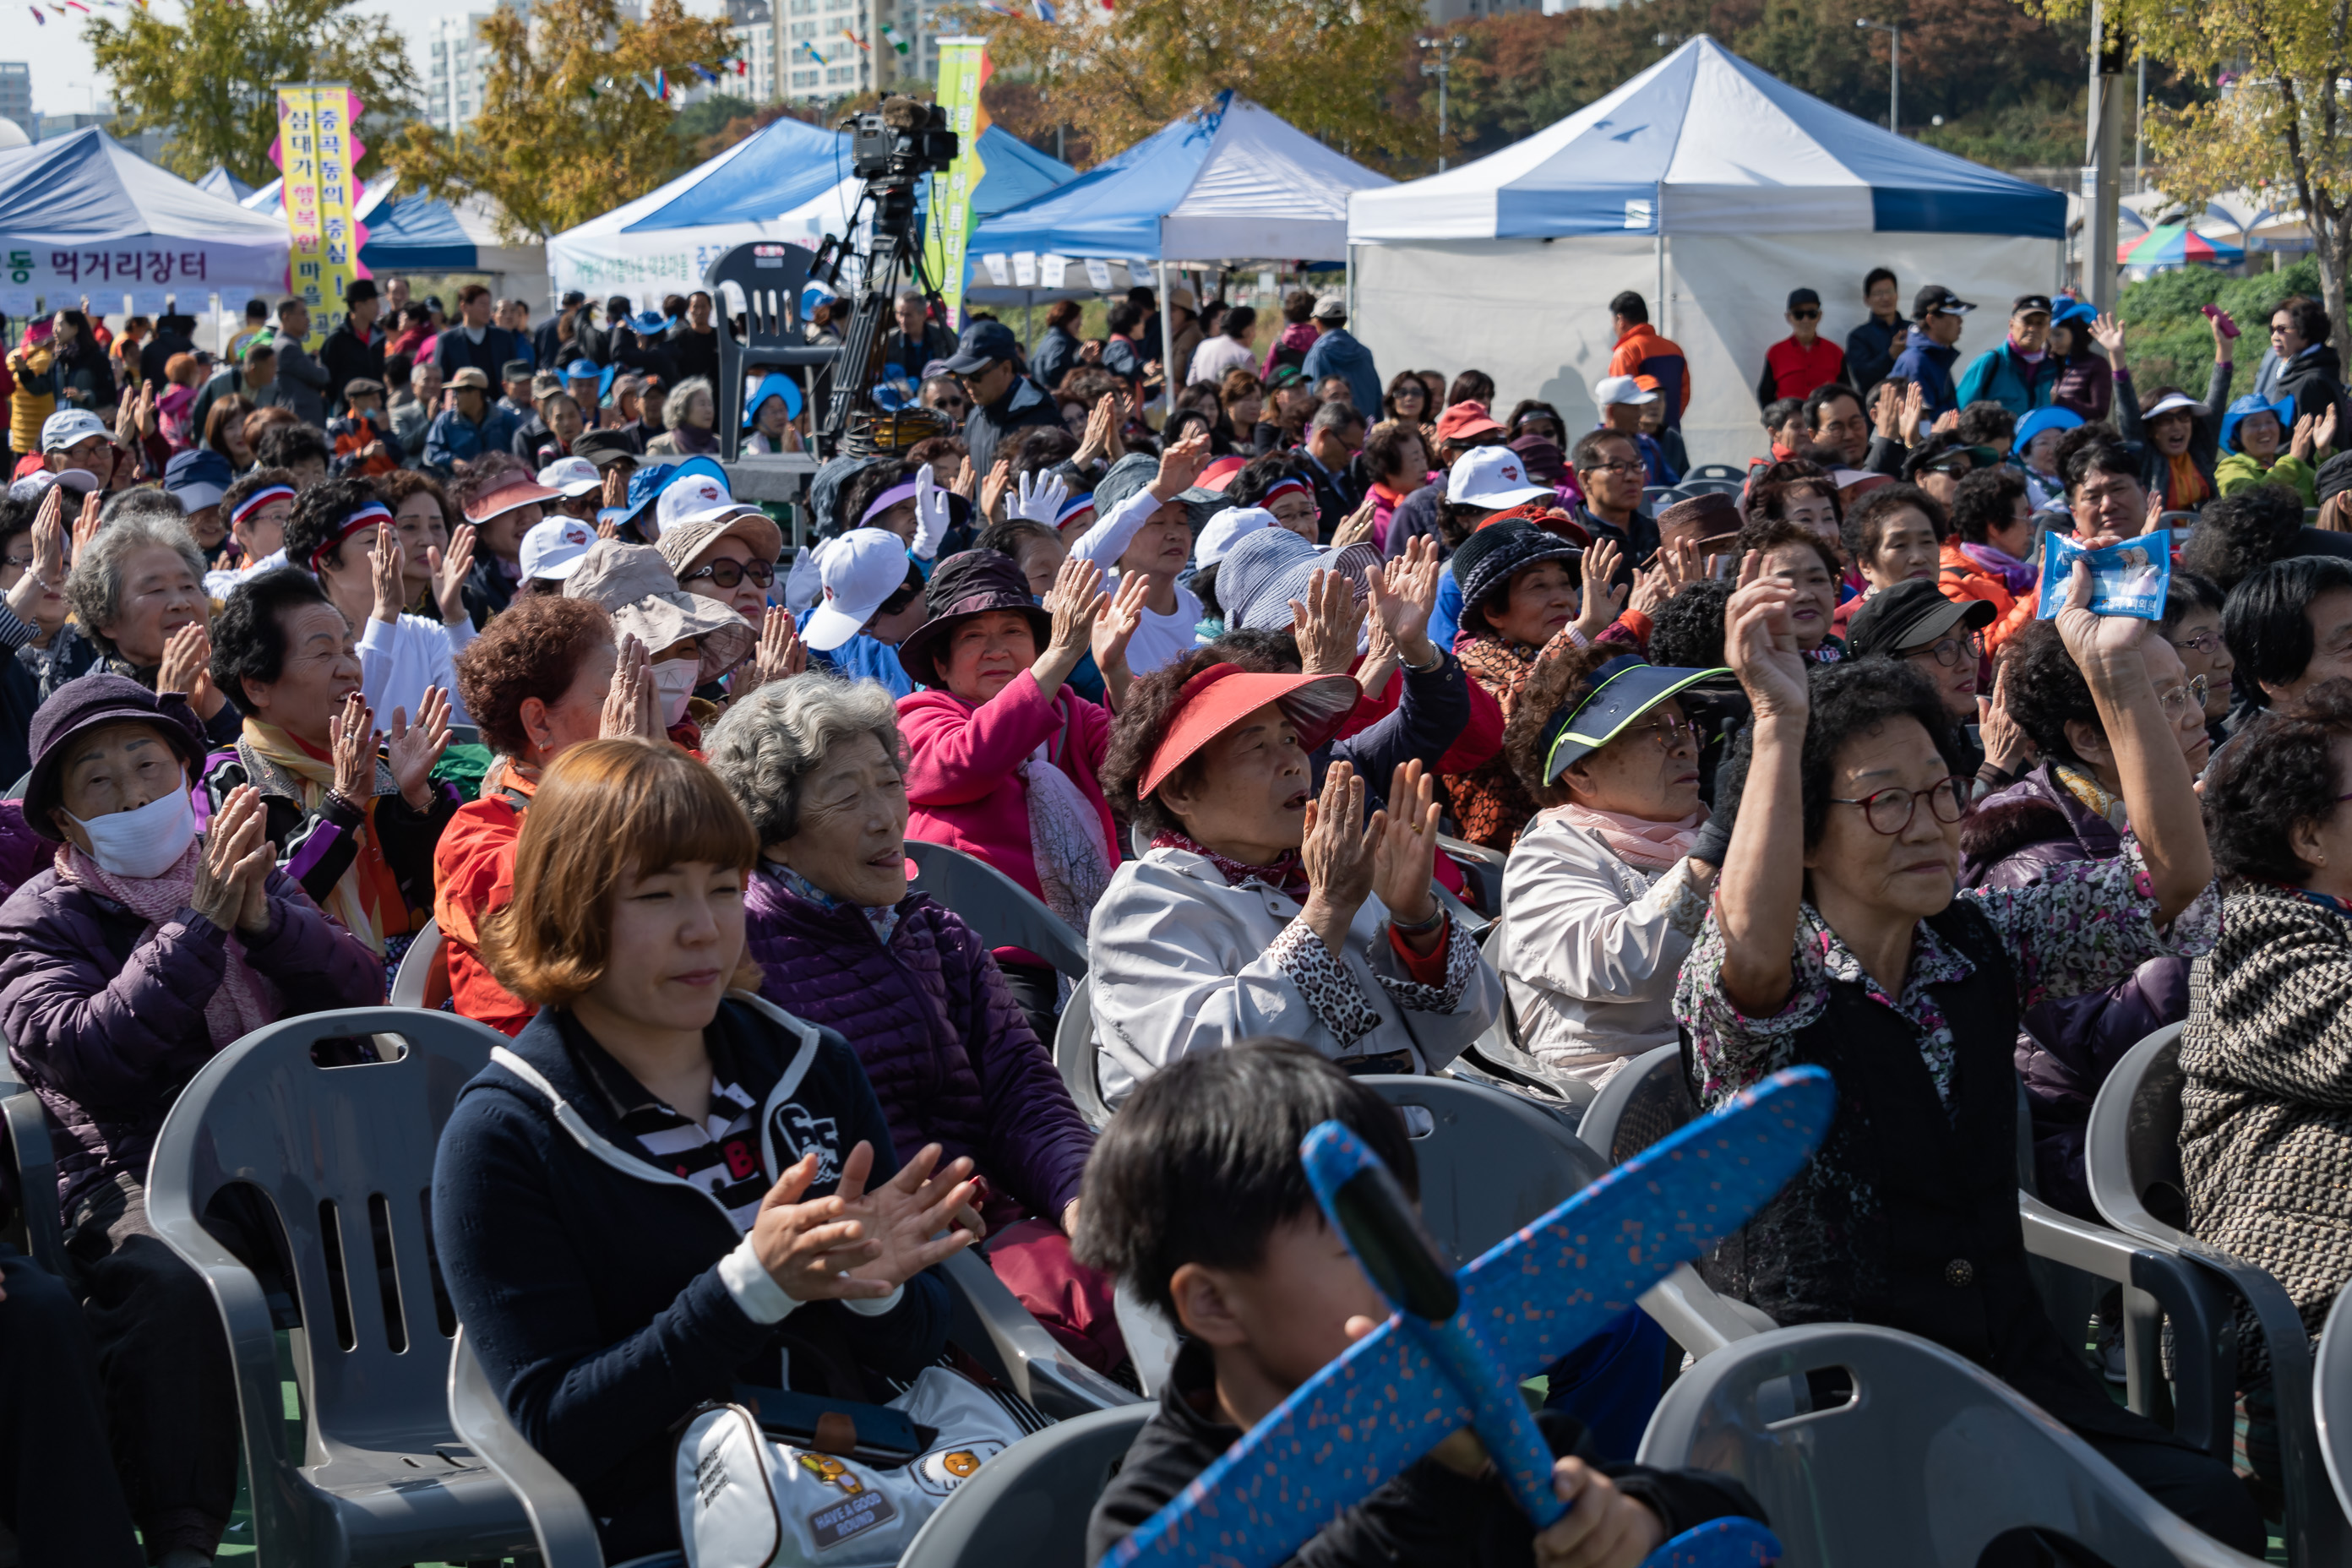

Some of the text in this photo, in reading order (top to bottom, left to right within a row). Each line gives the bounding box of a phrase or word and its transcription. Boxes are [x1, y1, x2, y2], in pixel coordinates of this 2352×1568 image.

[317, 111, 344, 205] 중곡동의
[290, 112, 322, 306] 삼대가 행복한 마을
[52, 250, 206, 284] 먹거리장터
[324, 219, 347, 296] 중심!
[814, 1492, 882, 1531] HAVE A GOOD
[836, 1510, 875, 1537] ROUND
